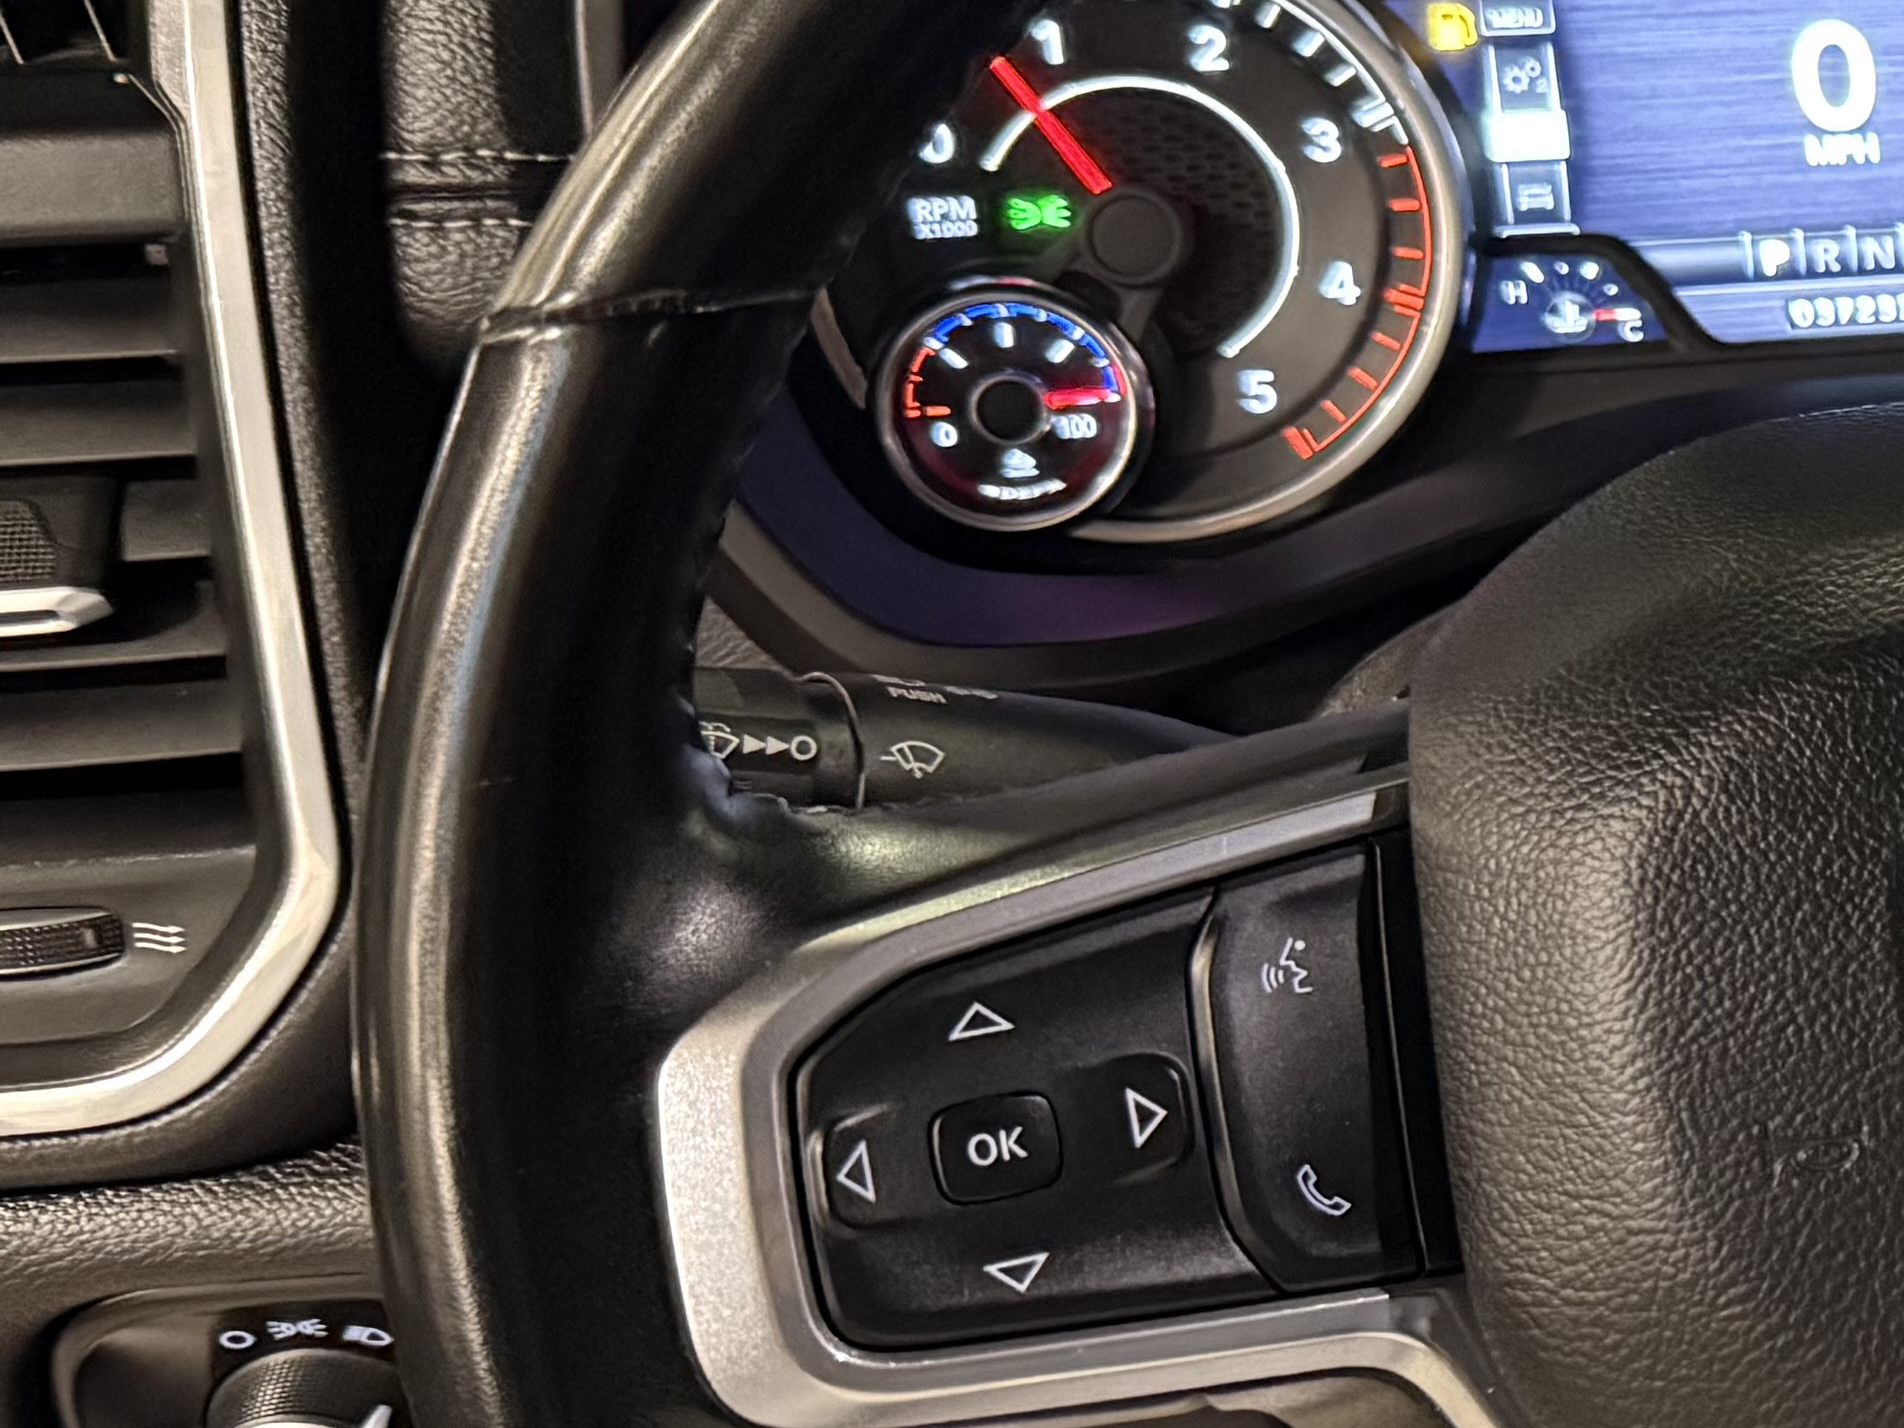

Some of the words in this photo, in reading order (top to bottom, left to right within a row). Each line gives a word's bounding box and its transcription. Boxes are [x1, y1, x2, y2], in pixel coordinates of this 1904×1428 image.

[1029, 18, 1064, 65] 1
[1188, 24, 1230, 72] 2
[1791, 18, 1877, 132] 0
[1302, 117, 1342, 163] 3
[1804, 131, 1881, 166] MPH
[907, 195, 977, 222] RPM
[1759, 238, 1790, 276] P
[1814, 238, 1841, 272] R
[1861, 235, 1895, 270] N
[1319, 260, 1361, 305] 4
[1500, 280, 1528, 305] H
[1617, 319, 1644, 342] C
[1237, 368, 1277, 414] 5
[930, 421, 958, 448] 0
[1052, 413, 1098, 440] 100
[966, 1125, 1029, 1167] OK
